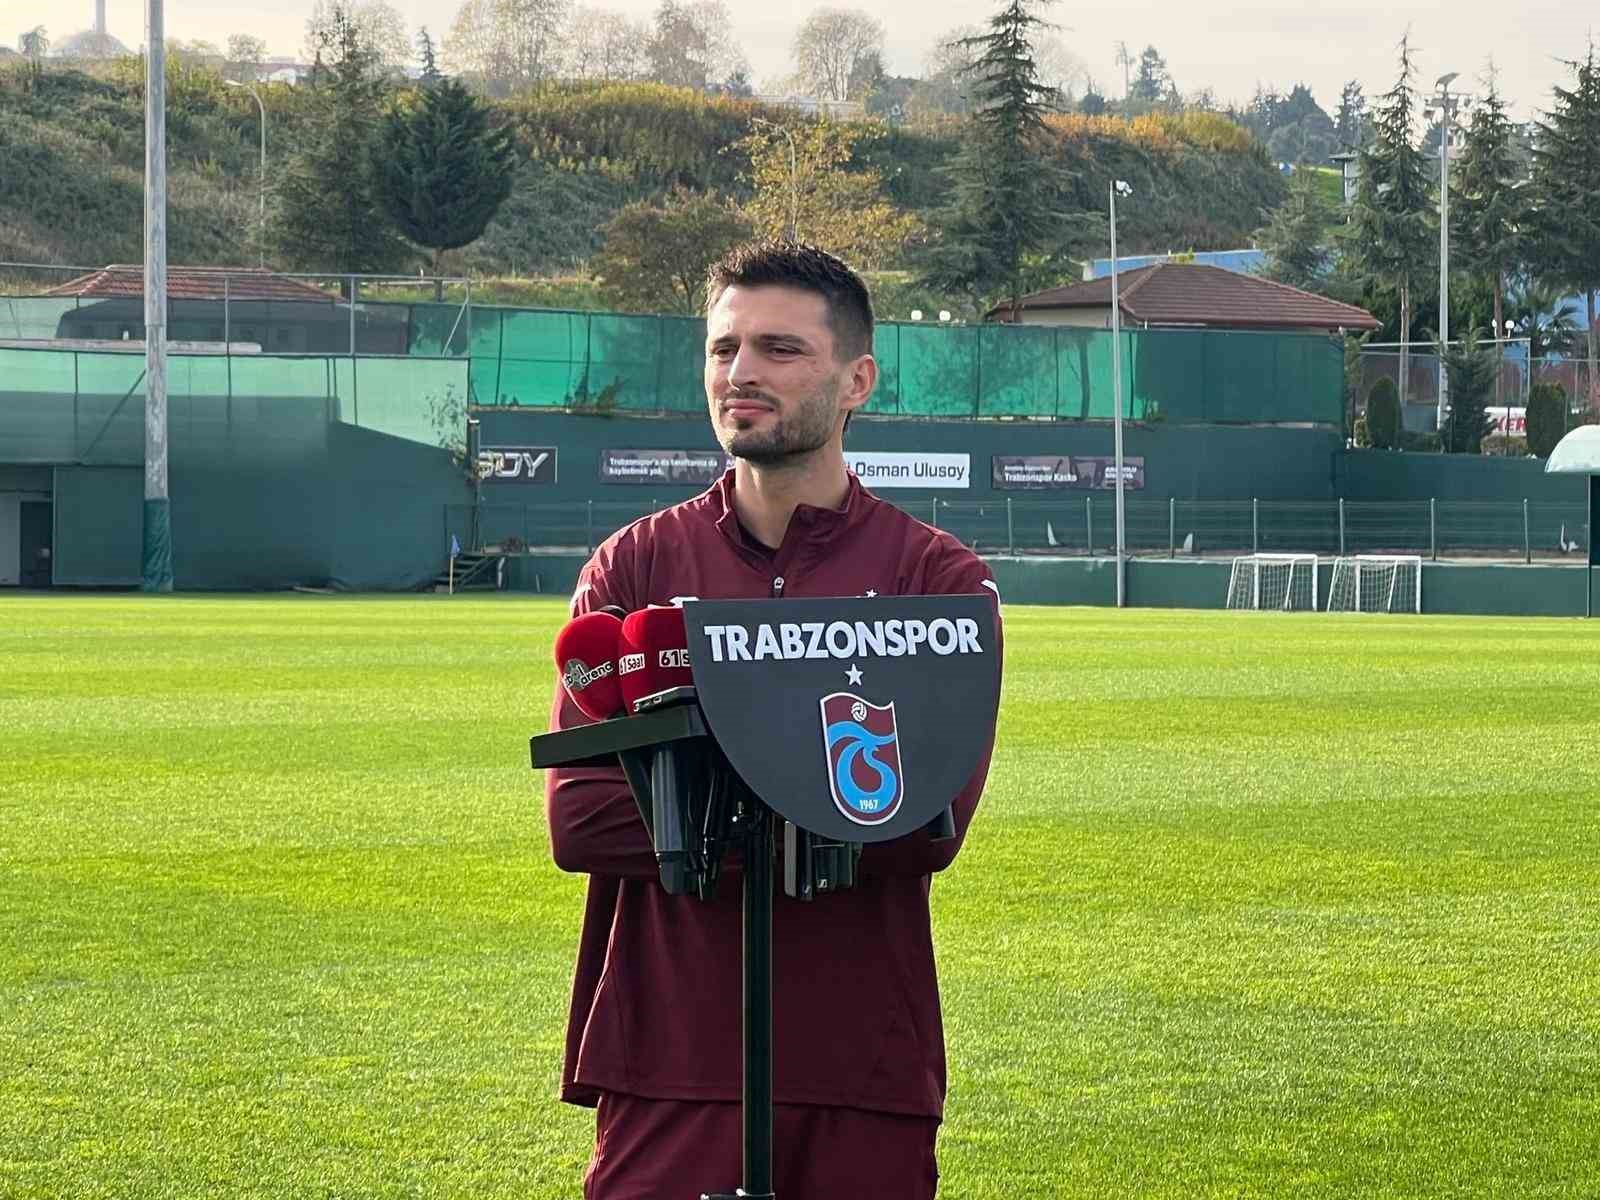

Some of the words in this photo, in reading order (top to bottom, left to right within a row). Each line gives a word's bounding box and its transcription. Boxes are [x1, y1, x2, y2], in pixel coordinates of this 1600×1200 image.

[855, 461, 910, 478] Osman
[913, 461, 966, 481] Ulusoy
[703, 617, 985, 663] TRABZONSPOR
[661, 650, 680, 667] 61
[859, 799, 879, 811] 1967
